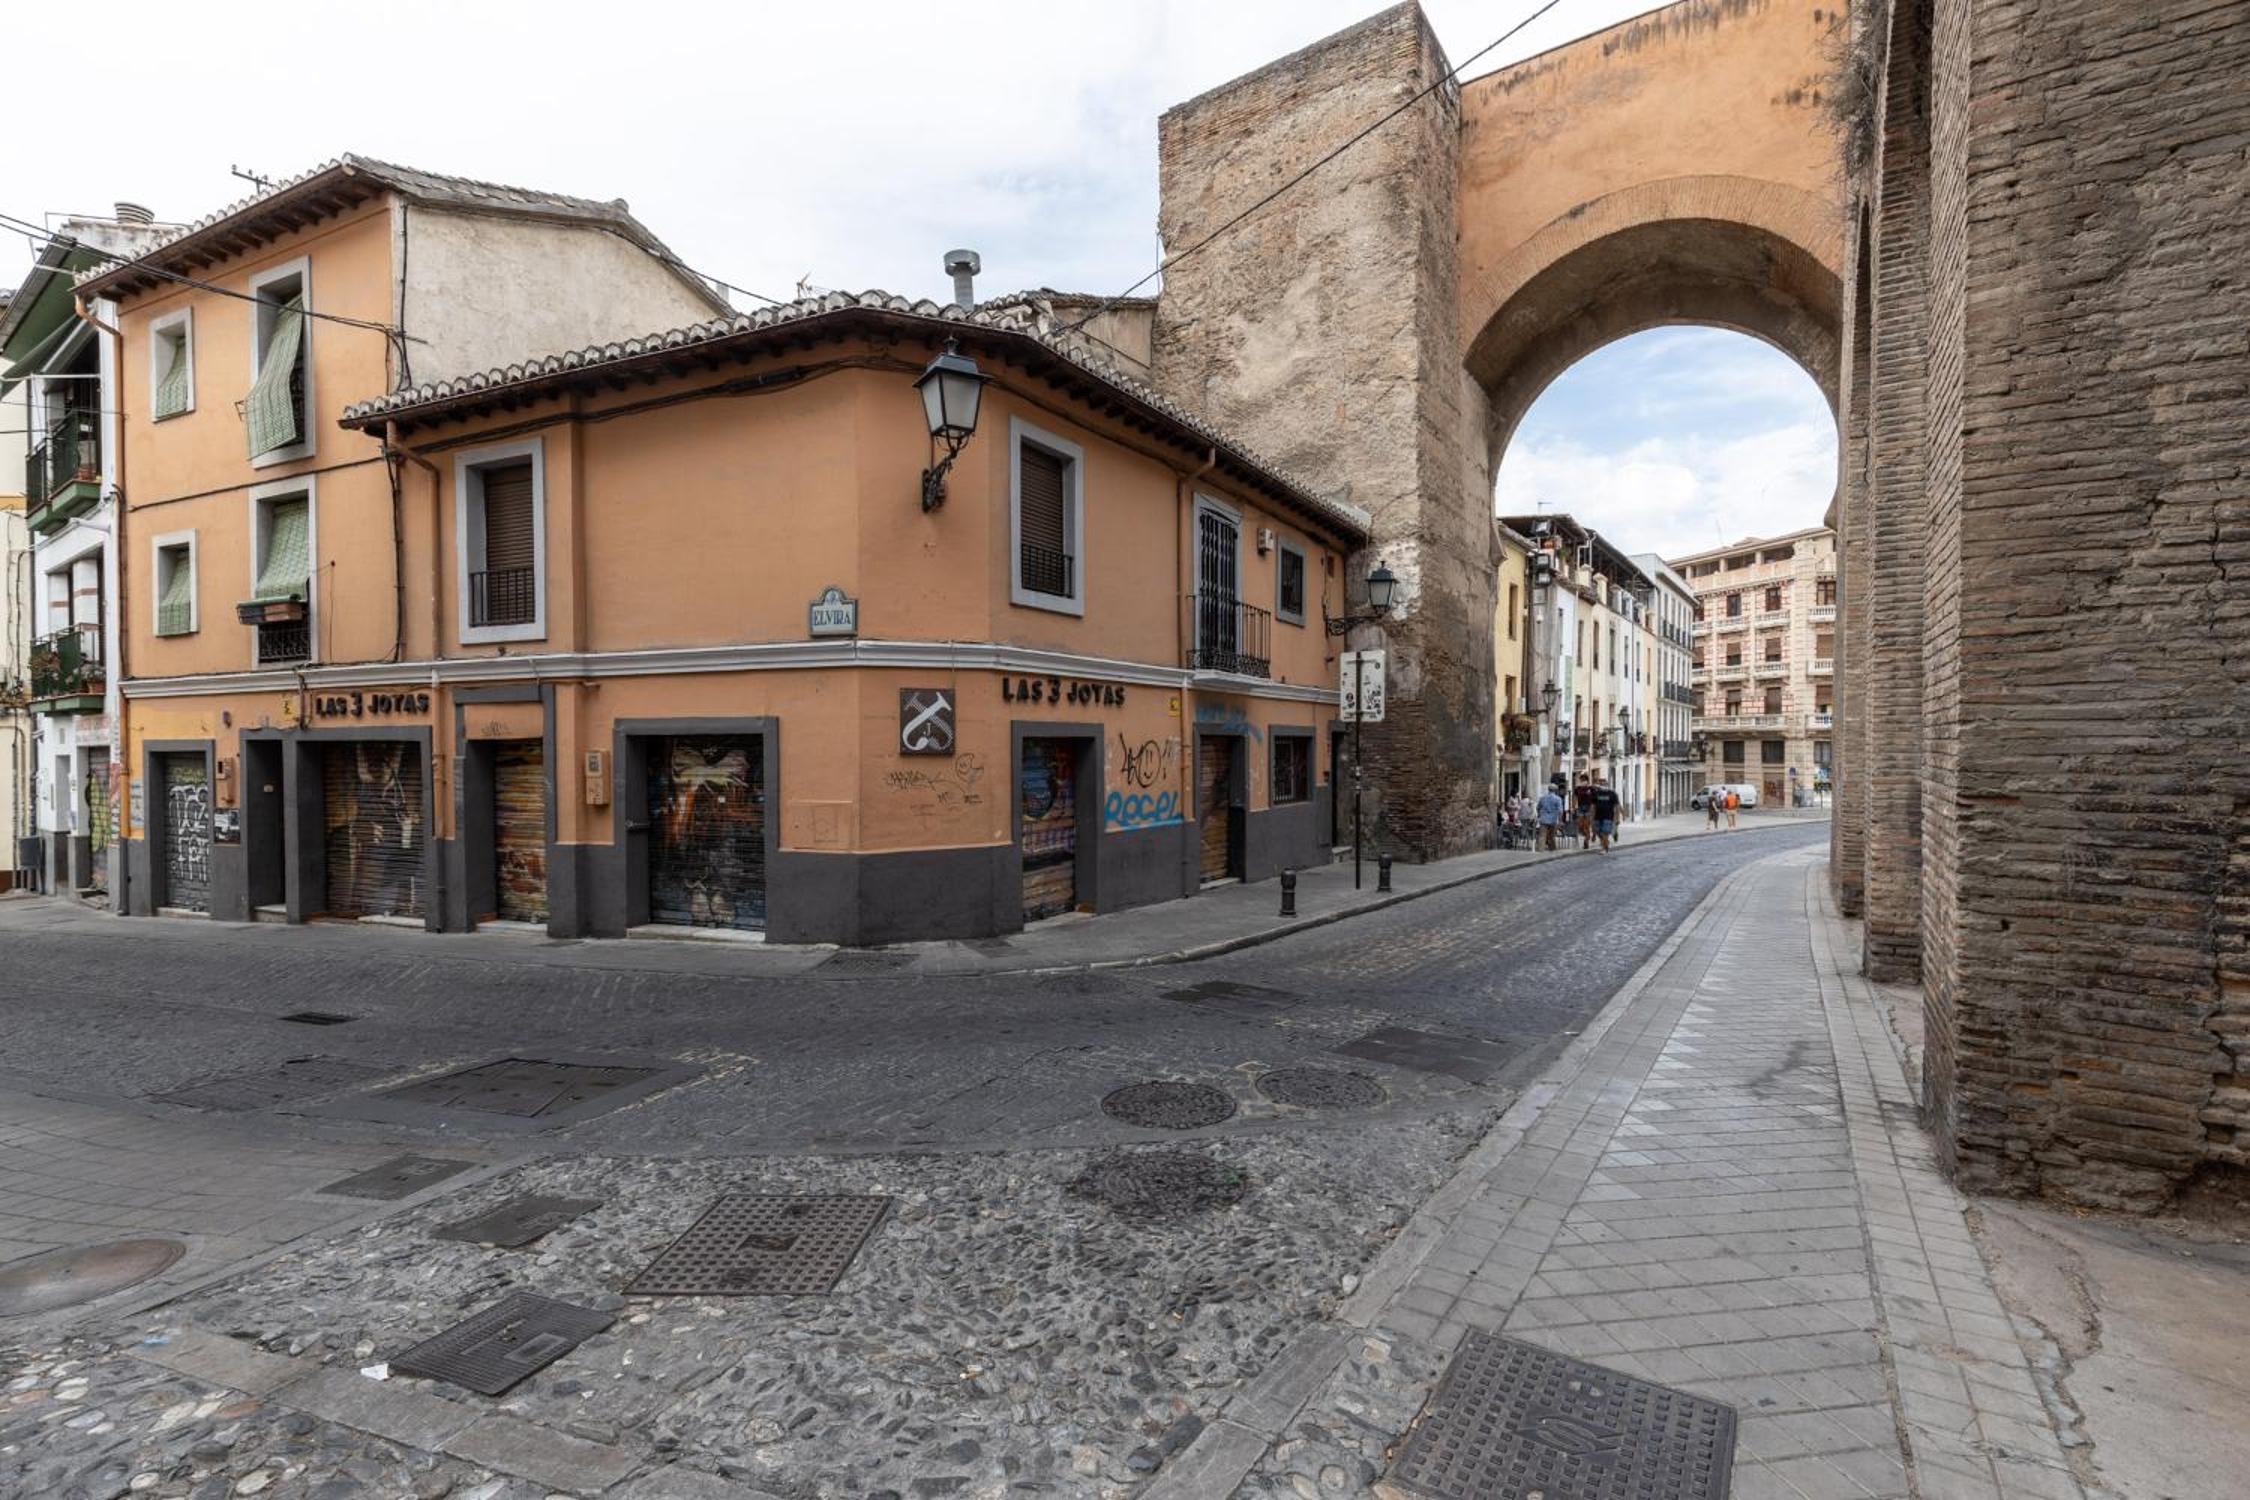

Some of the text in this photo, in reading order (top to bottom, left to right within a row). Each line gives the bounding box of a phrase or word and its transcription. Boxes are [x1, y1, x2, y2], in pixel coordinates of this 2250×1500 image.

[814, 609, 851, 626] ELVIRA
[316, 690, 429, 717] LAS 3 JOTAS
[1002, 676, 1125, 706] LAS 3 JOTAS
